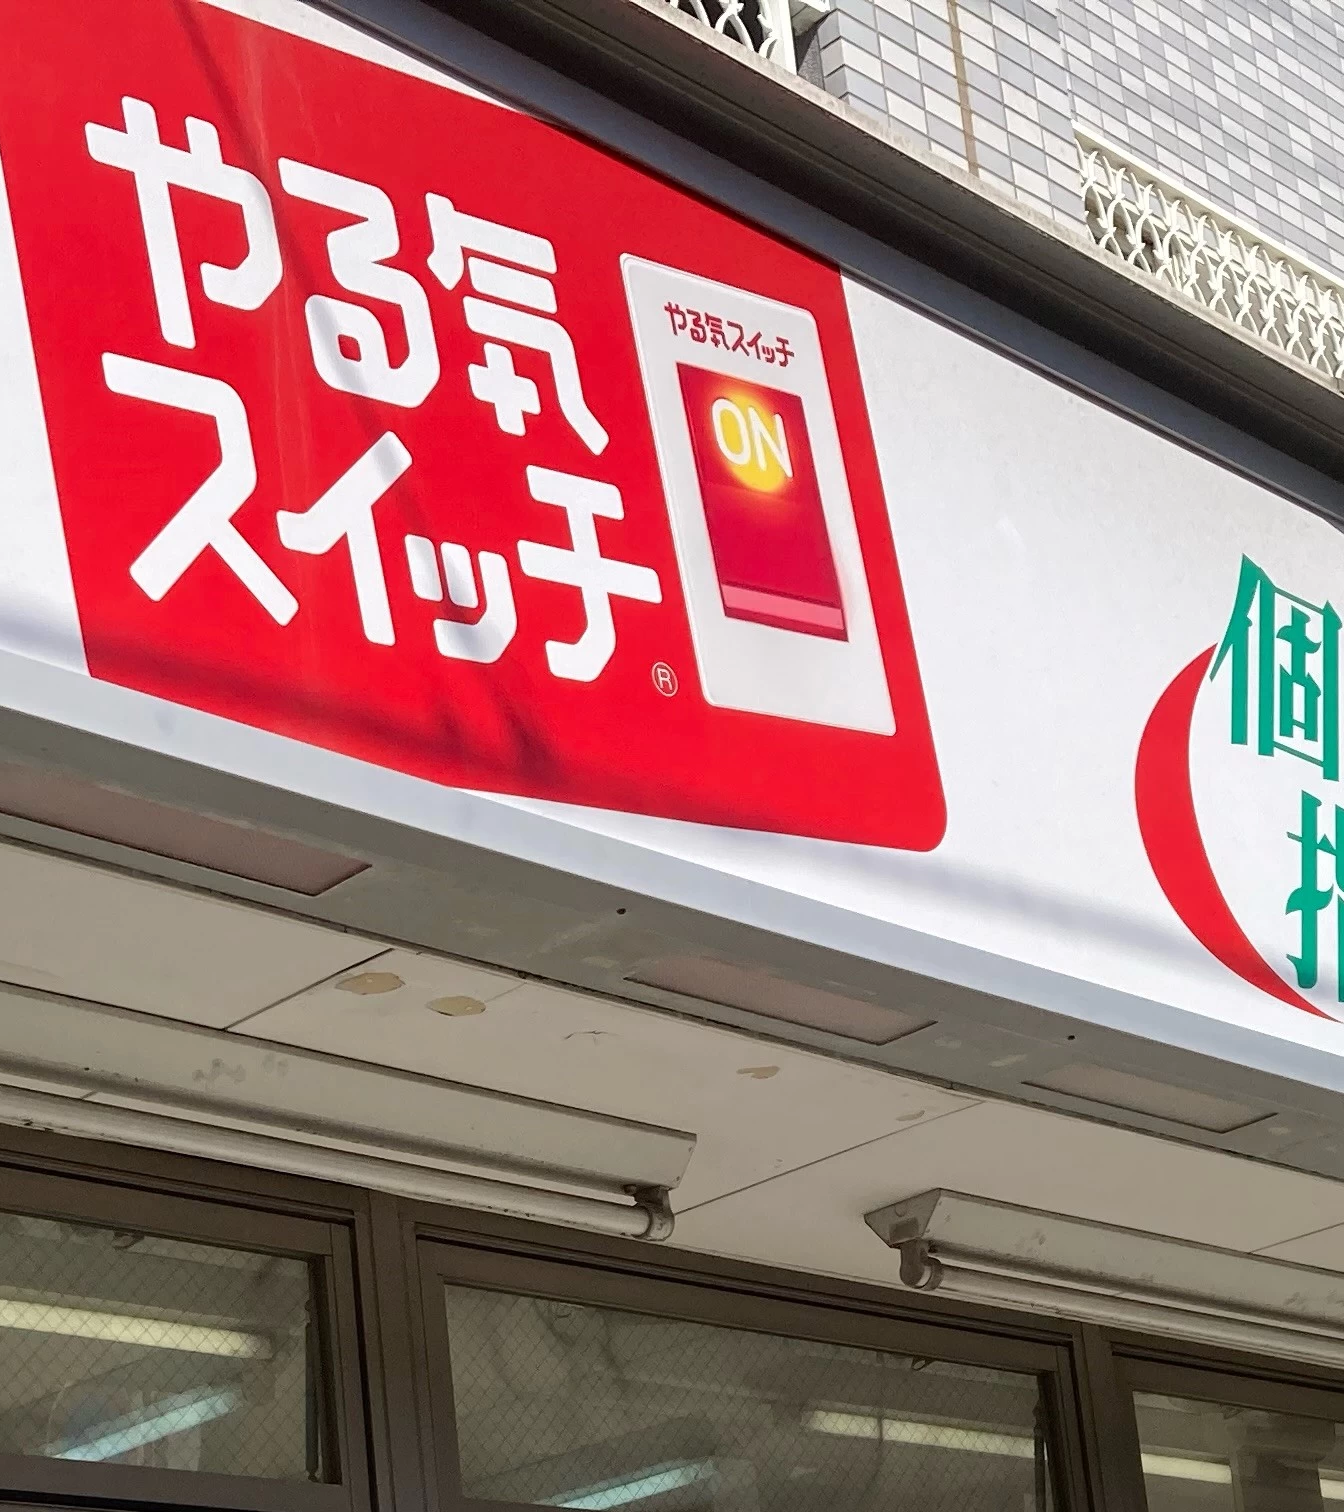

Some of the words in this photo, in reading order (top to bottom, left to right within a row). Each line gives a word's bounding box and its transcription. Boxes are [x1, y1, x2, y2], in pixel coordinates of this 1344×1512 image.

[85, 96, 609, 455] やる気
[664, 302, 794, 367] やる気スイッチ
[102, 352, 662, 681] スイッチ
[712, 398, 793, 478] ON
